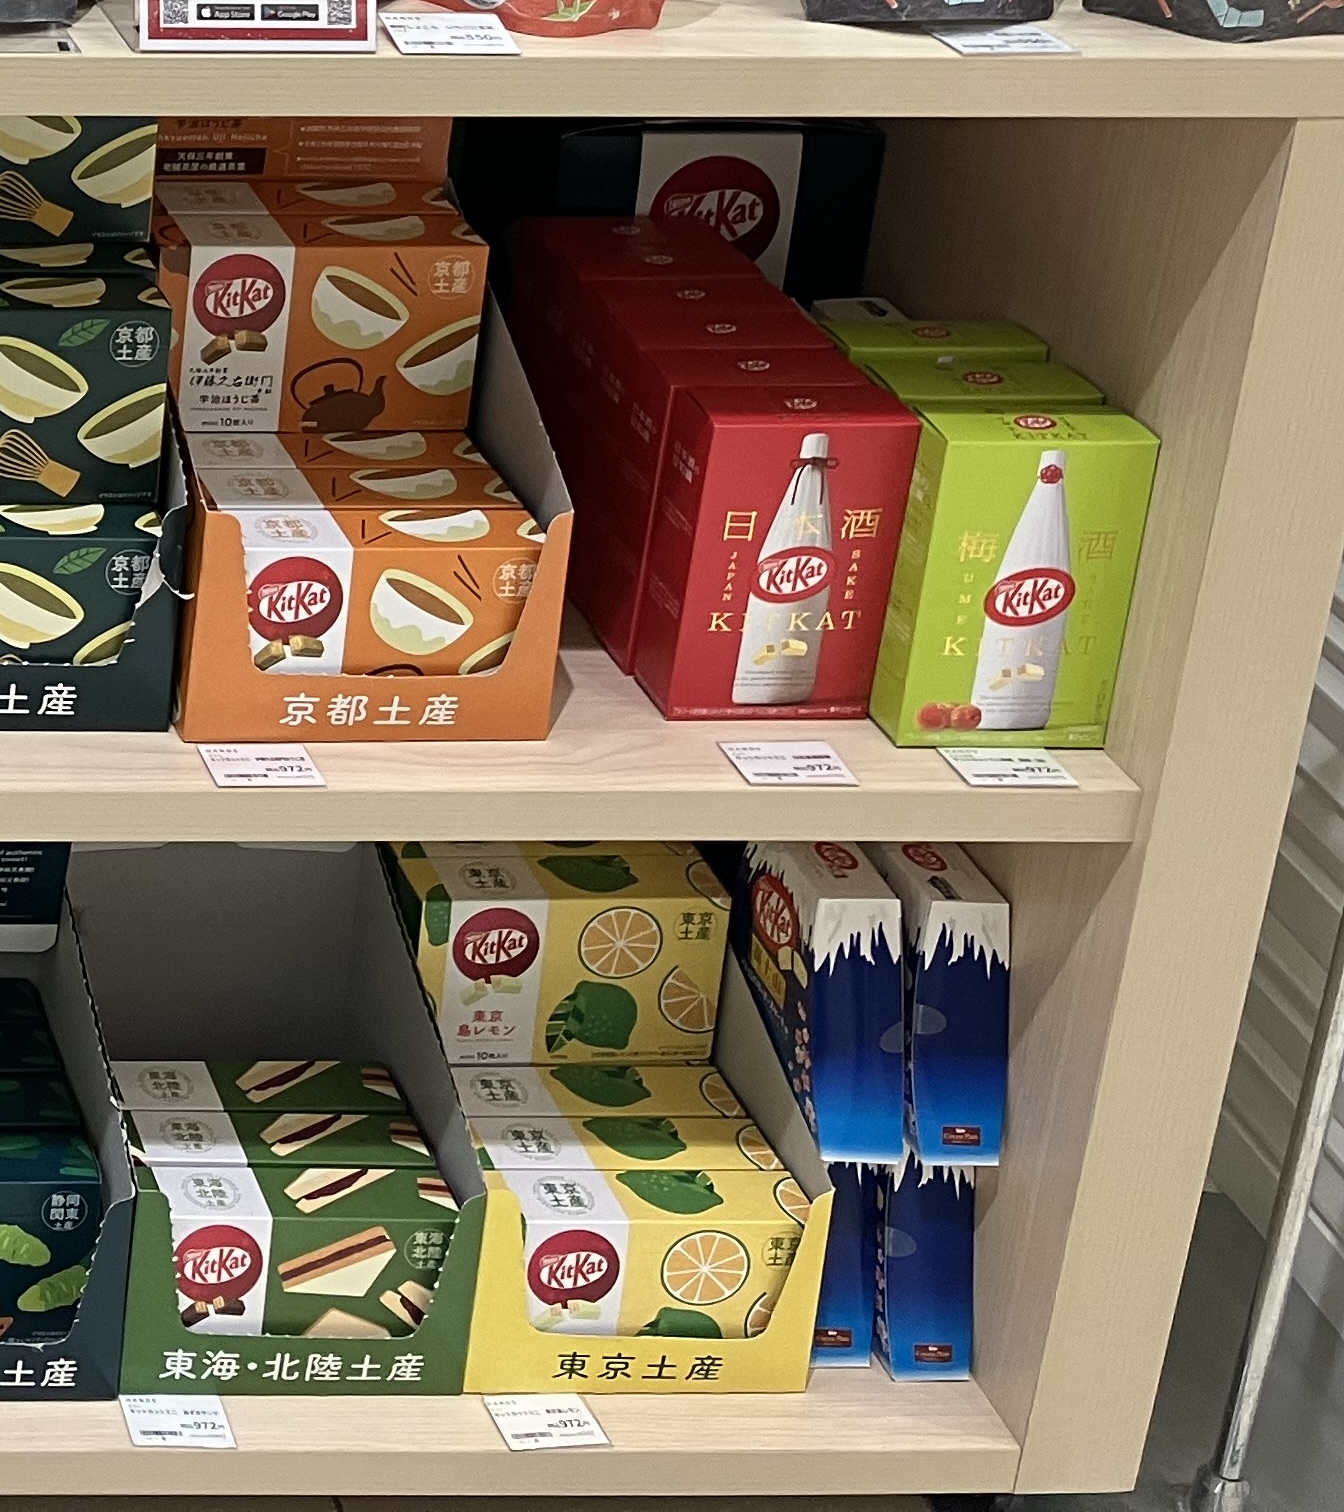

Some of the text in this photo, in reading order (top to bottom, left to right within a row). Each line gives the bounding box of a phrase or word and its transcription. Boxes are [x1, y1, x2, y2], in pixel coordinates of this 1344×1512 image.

[214, 10, 251, 19] App Store
[277, 10, 301, 19] Google
[211, 277, 274, 316] KitKat
[114, 325, 155, 343] 京都
[114, 344, 155, 362] 土産
[759, 555, 827, 593] KitKat
[257, 581, 331, 623] KitKat
[993, 580, 1066, 618] KitKat
[278, 693, 459, 727] 京都土産
[464, 930, 531, 965] KitKat
[457, 1023, 517, 1040] 島レモン
[472, 1008, 504, 1023] 東京
[185, 1246, 256, 1283] KitKat
[538, 1251, 610, 1289] KitKat
[157, 1350, 427, 1384] 東海・北陸土産
[551, 1352, 724, 1383] 東京土産
